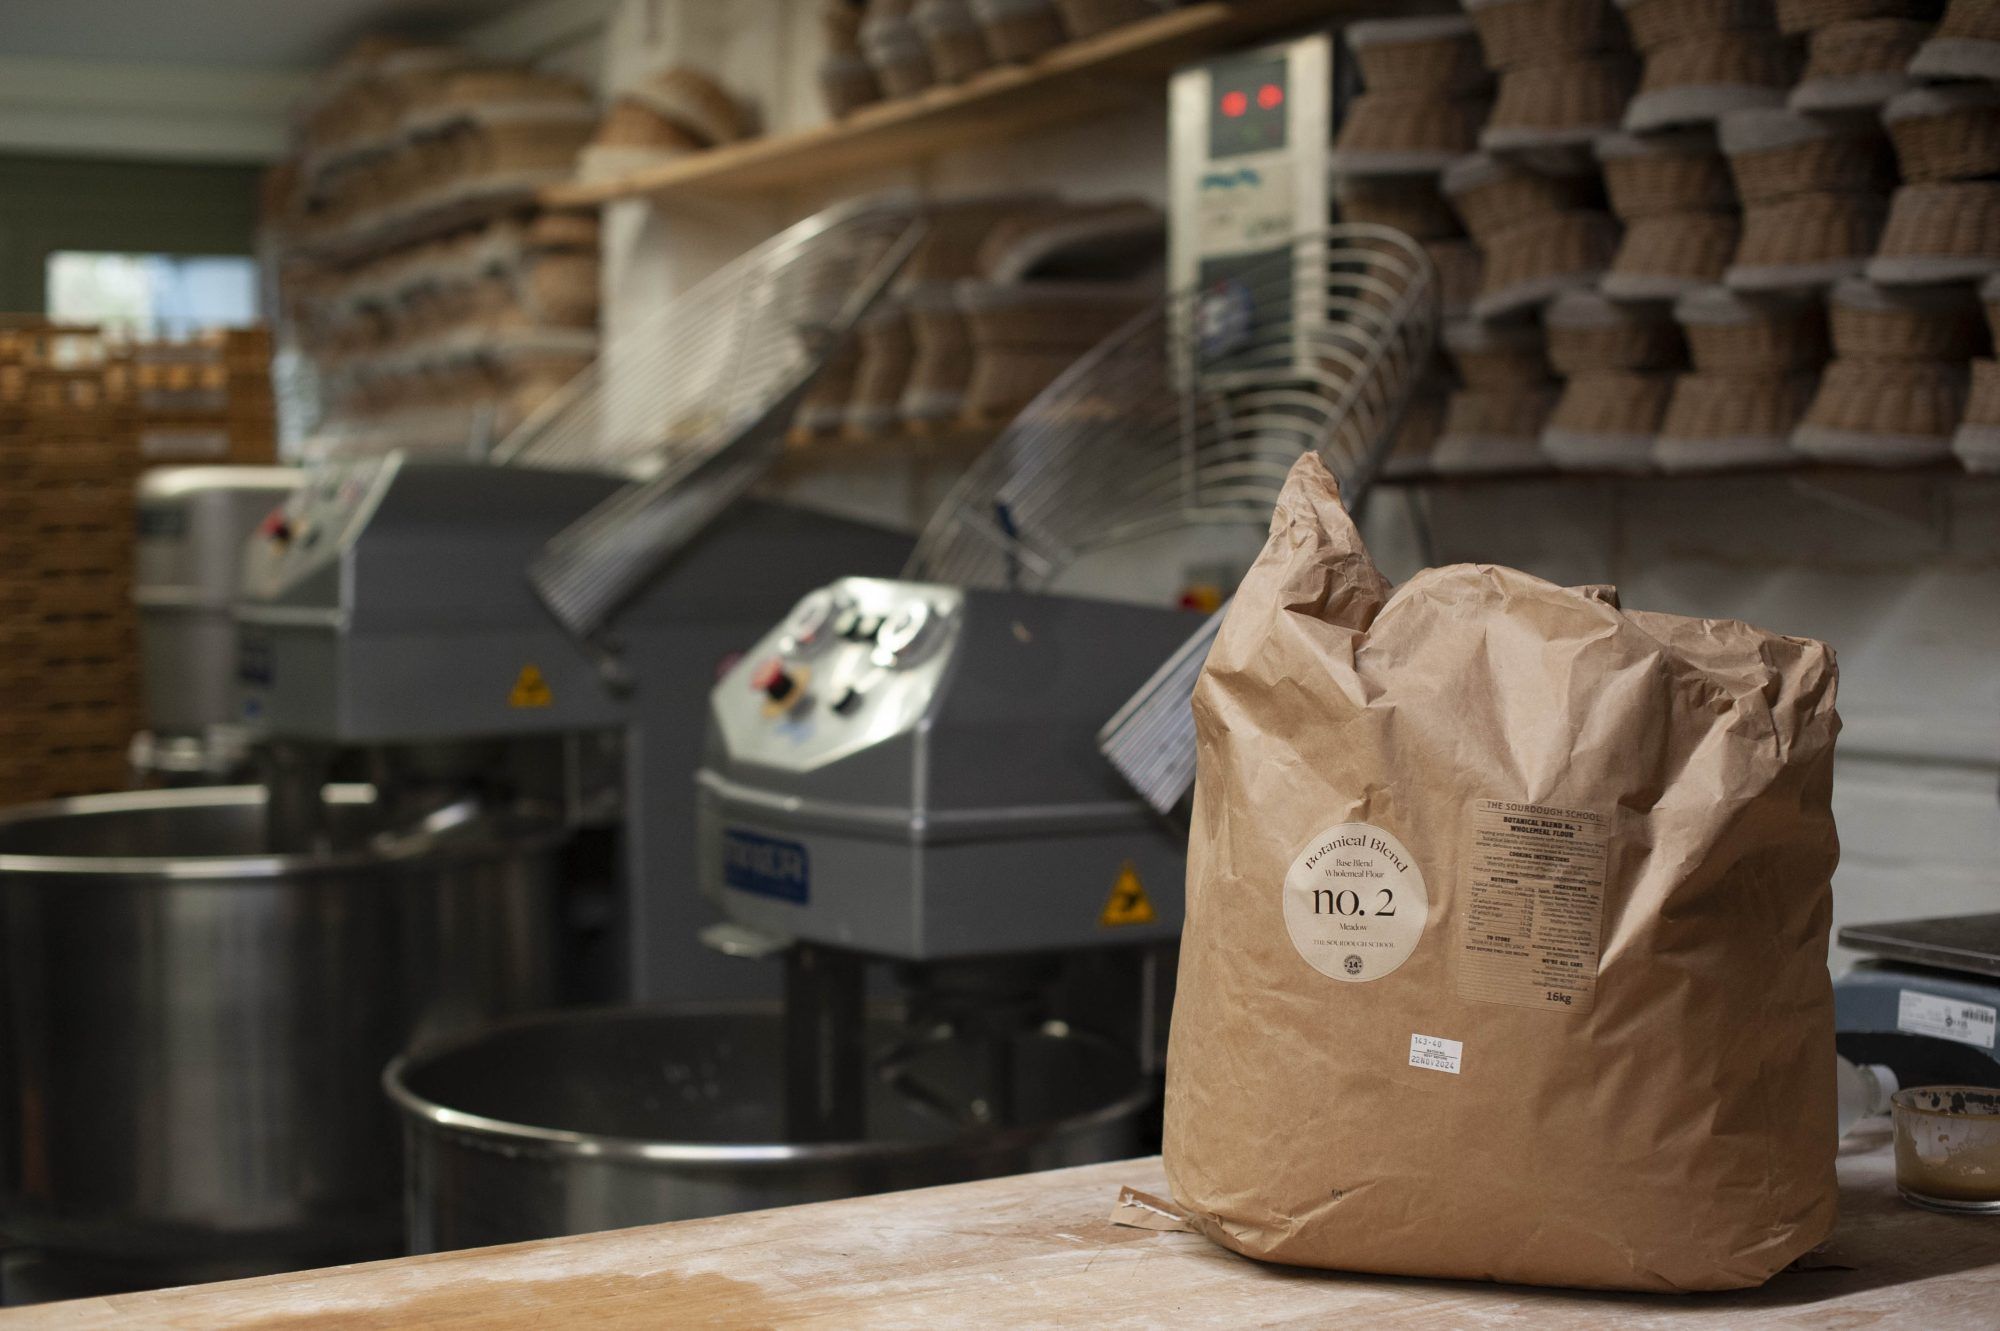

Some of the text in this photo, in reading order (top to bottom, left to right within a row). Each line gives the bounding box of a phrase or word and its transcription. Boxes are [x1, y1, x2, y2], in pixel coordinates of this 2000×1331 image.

[1487, 801, 1601, 822] THE SOURDOUGH SCHOOL
[1504, 816, 1539, 827] BOTANICAL
[1541, 821, 1562, 829] BLEND
[1511, 824, 1574, 838] WHOLEMEAL FLOUR
[1306, 835, 1408, 873] Botanical Blend
[1325, 870, 1384, 878] Wholemeal Flour
[1312, 888, 1397, 916] no. 2
[1546, 991, 1572, 1005] 16kg
